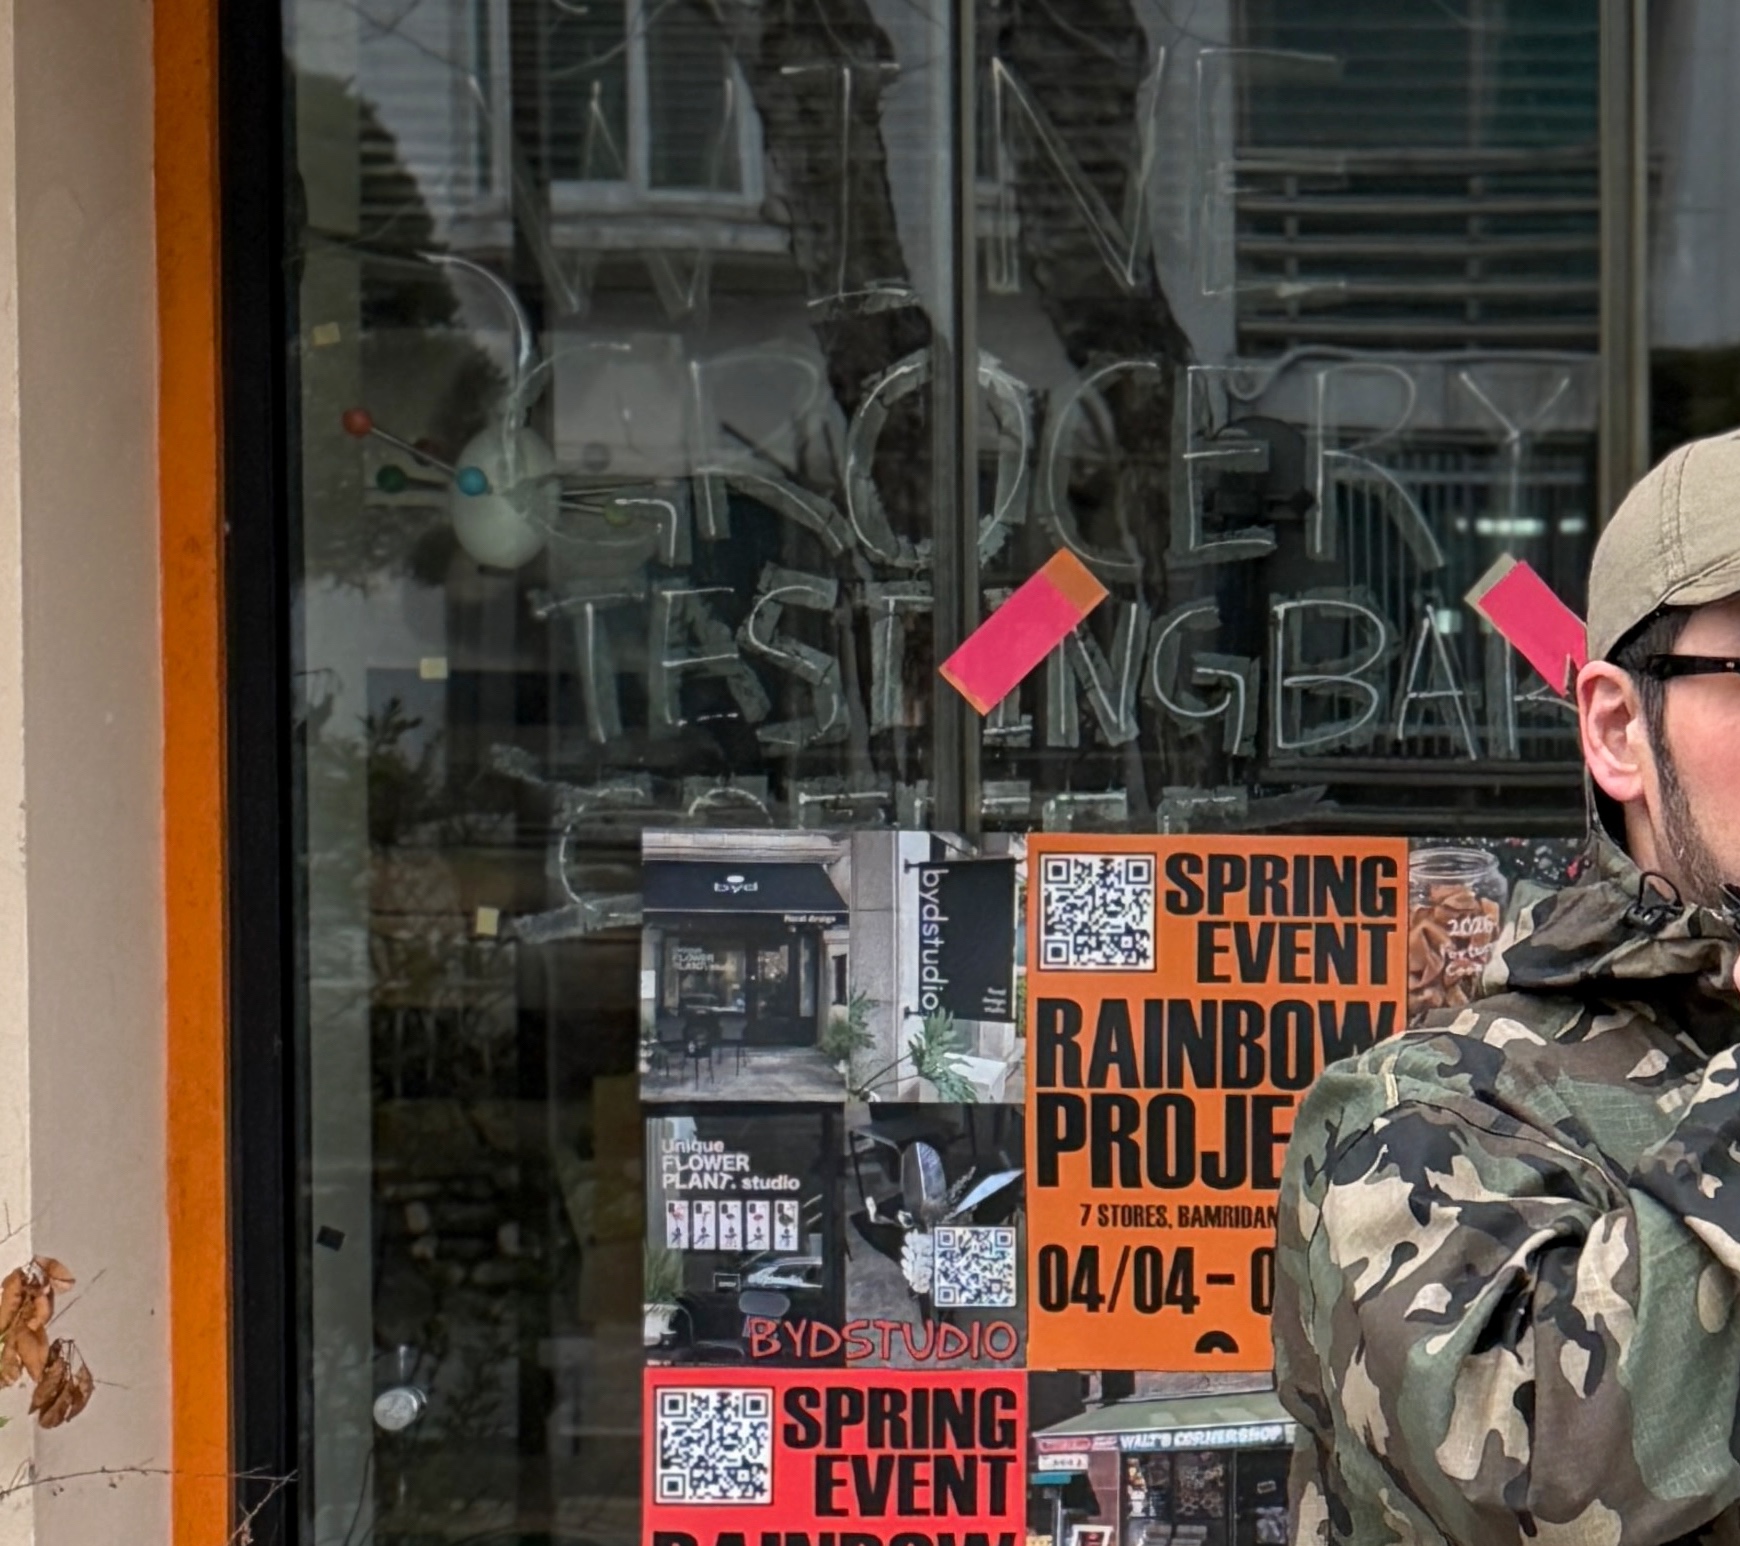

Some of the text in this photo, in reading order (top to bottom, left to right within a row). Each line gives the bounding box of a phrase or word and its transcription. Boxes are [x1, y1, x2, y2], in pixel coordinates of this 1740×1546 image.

[1164, 852, 1398, 918] SPRING
[919, 868, 950, 1011] bydstudio
[1196, 921, 1397, 986] EVENT
[662, 1139, 725, 1155] Unique
[662, 1154, 750, 1172] FLOWER
[741, 1174, 801, 1191] studio
[1079, 1205, 1091, 1227] 7
[1097, 1204, 1173, 1230] STORES,
[748, 1317, 1017, 1363] BYDSTUDIO
[783, 1386, 1016, 1452] SPRING
[815, 1454, 1015, 1517] EVENT
